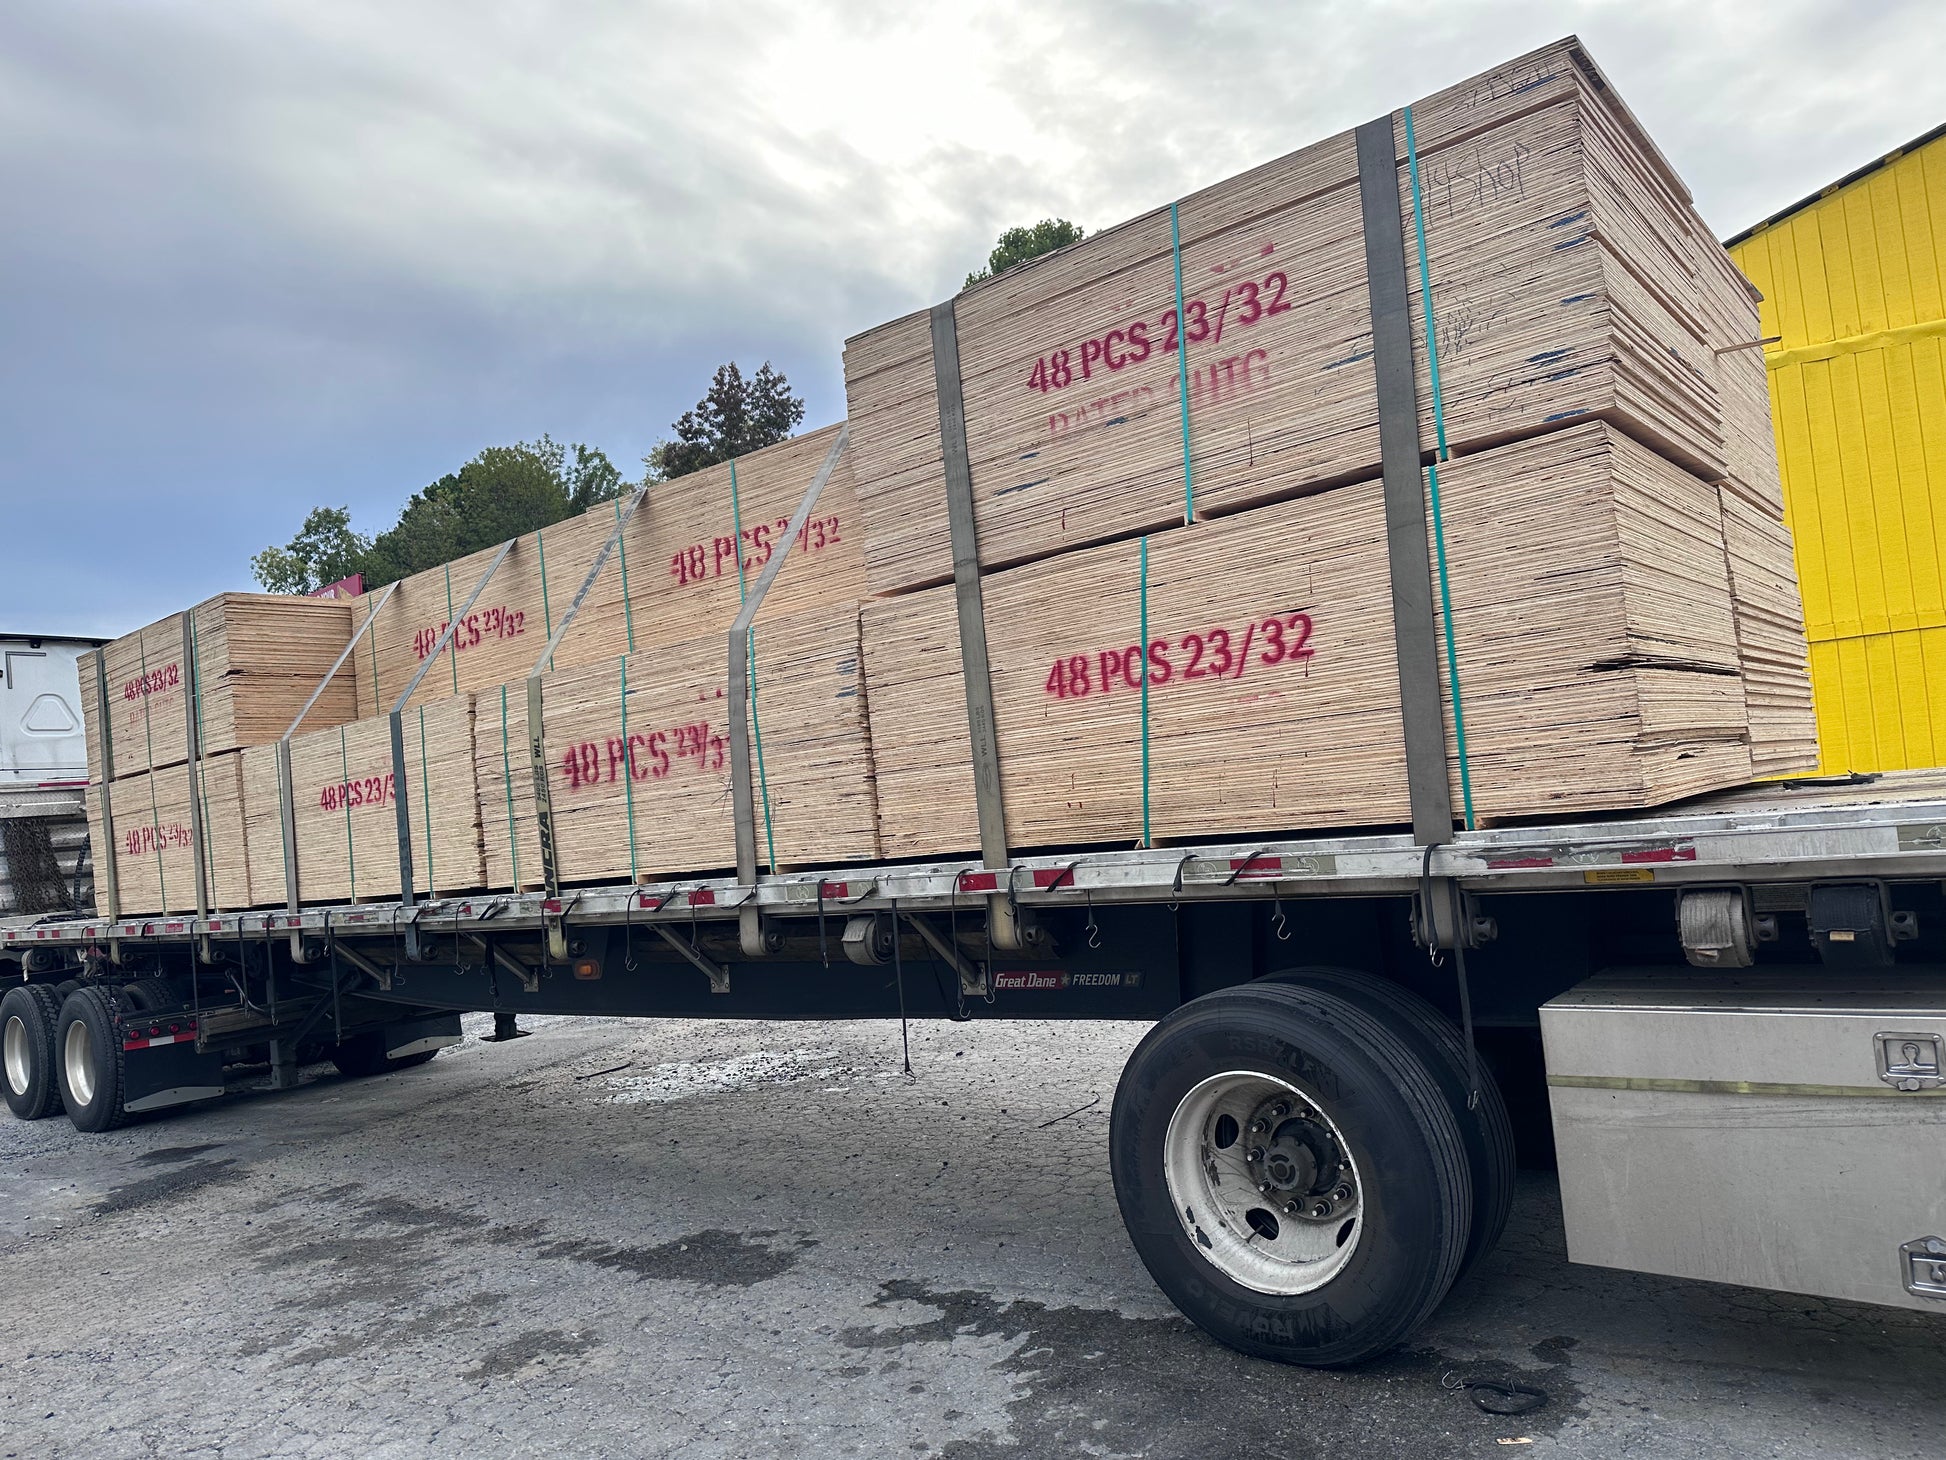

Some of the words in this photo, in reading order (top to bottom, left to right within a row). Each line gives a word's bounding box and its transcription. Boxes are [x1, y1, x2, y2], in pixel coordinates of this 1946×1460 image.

[1027, 351, 1072, 392] 48
[1080, 322, 1151, 379] PCS
[1160, 272, 1291, 353] 23/32
[670, 544, 705, 584] 48
[714, 525, 771, 577] PCS
[776, 515, 841, 551] 2/32
[413, 628, 436, 659] 48
[483, 606, 525, 638] 23/32
[1046, 656, 1091, 698] 48
[1100, 640, 1172, 693] PCS
[1181, 614, 1315, 679] 23/32
[125, 681, 136, 701] 48
[136, 675, 151, 698] PCS
[152, 663, 179, 692] 23/32
[533, 736, 541, 758] WLL
[564, 742, 599, 789] 48
[607, 731, 670, 783] PCS
[673, 721, 730, 769] 23/3
[321, 786, 336, 810] 48
[338, 781, 362, 808] PCS
[365, 773, 396, 806] 23/3
[126, 830, 140, 854] 48
[143, 826, 167, 853] PCS
[168, 823, 193, 847] 23/32
[995, 973, 1026, 988] Great
[1027, 973, 1056, 987] Dane
[1072, 974, 1121, 986] FREEDOM
[1125, 974, 1138, 985] LT
